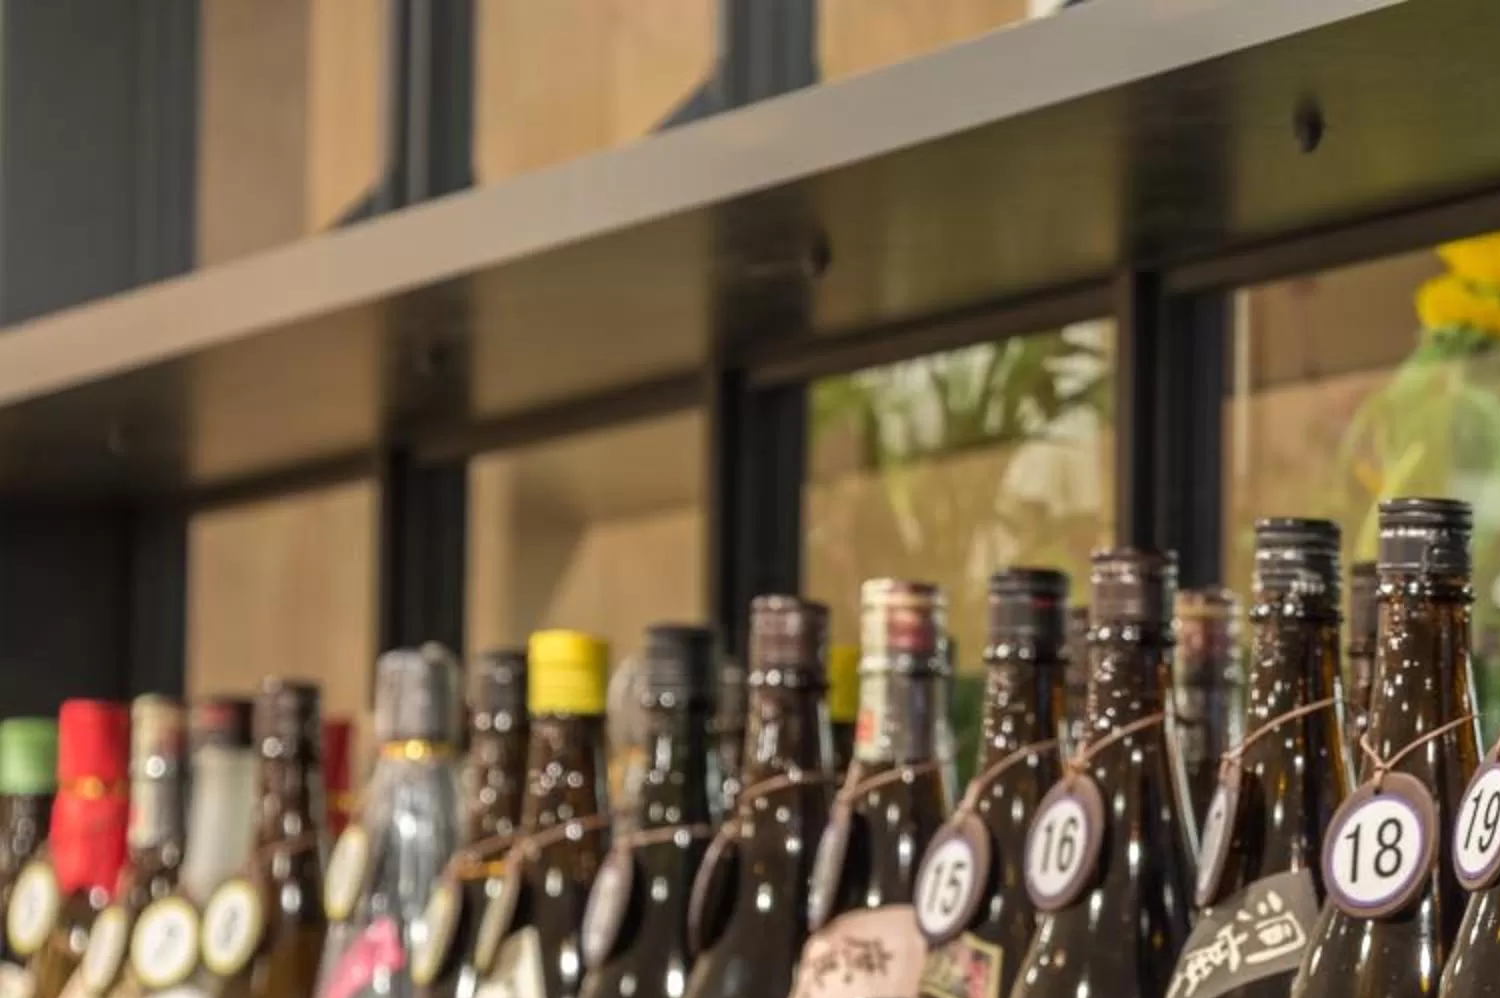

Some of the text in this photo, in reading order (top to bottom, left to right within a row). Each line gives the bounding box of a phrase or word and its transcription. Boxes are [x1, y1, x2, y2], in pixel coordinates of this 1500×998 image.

[1042, 816, 1078, 872] 16
[1344, 817, 1404, 884] 18
[930, 861, 968, 916] 15
